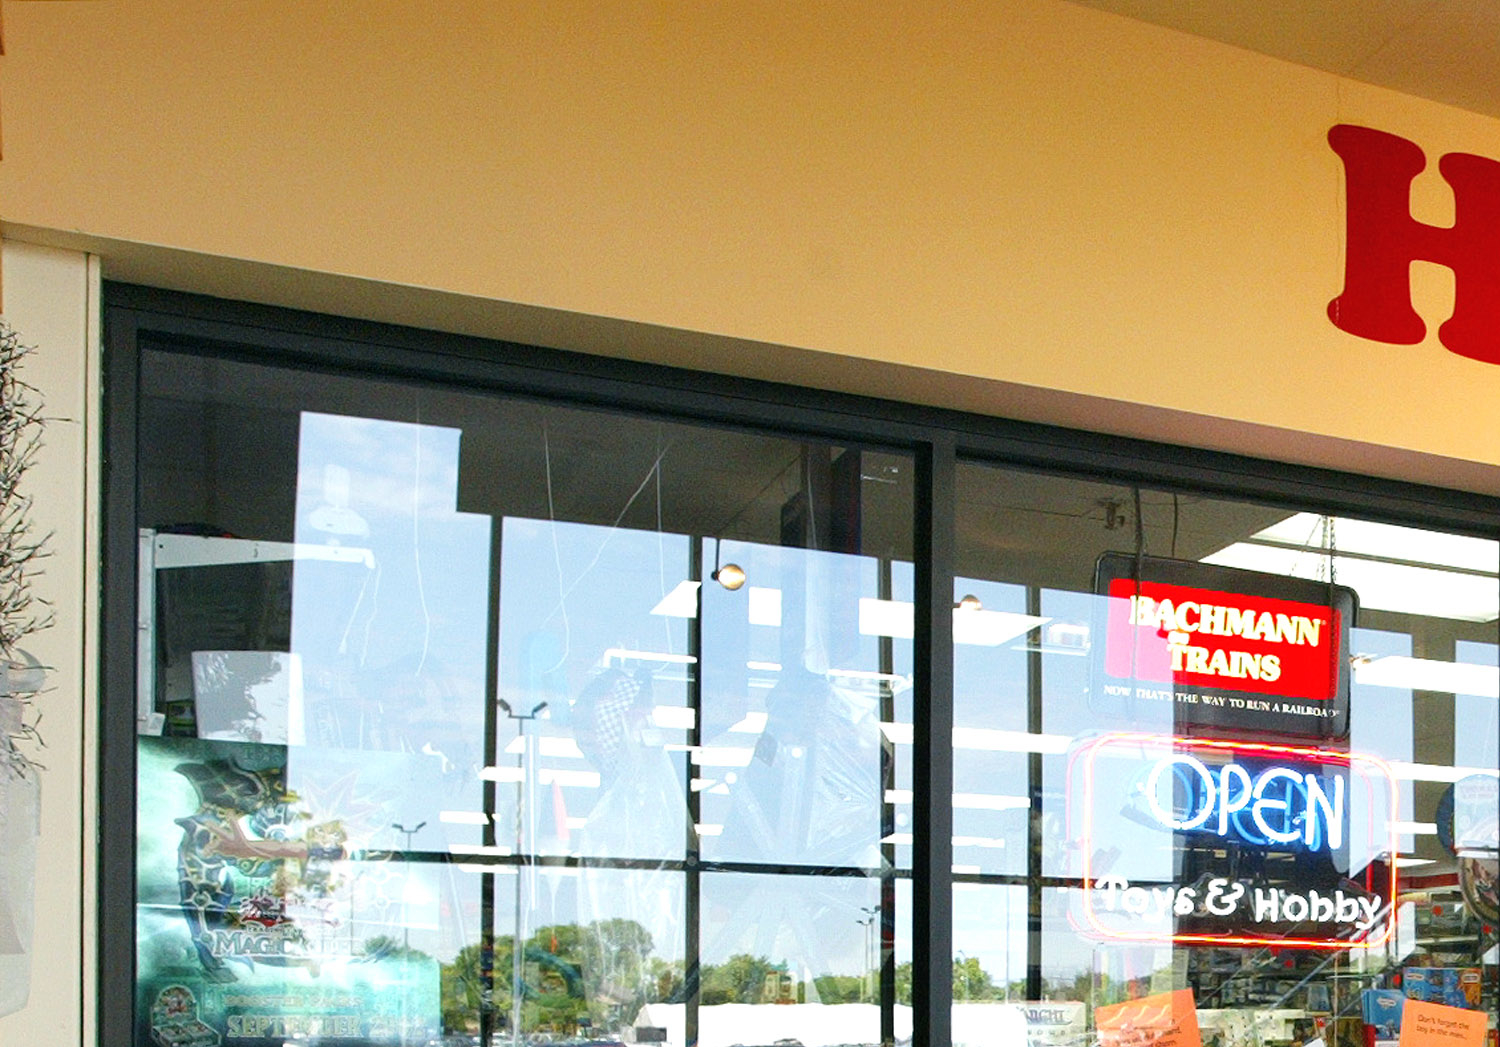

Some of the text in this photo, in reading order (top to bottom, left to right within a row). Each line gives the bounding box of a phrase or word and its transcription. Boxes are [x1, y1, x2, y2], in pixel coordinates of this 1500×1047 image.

[1129, 595, 1321, 647] BACHMANN
[1168, 634, 1281, 682] TRAINS
[1103, 685, 1132, 697] NOW
[1175, 692, 1199, 704] THE
[1201, 696, 1226, 707] WAY
[1229, 698, 1245, 708] TO
[1246, 700, 1270, 712] RUN
[1271, 703, 1280, 712] A
[1147, 753, 1344, 850] OPEN
[1094, 878, 1382, 929] Toys & Hobby
